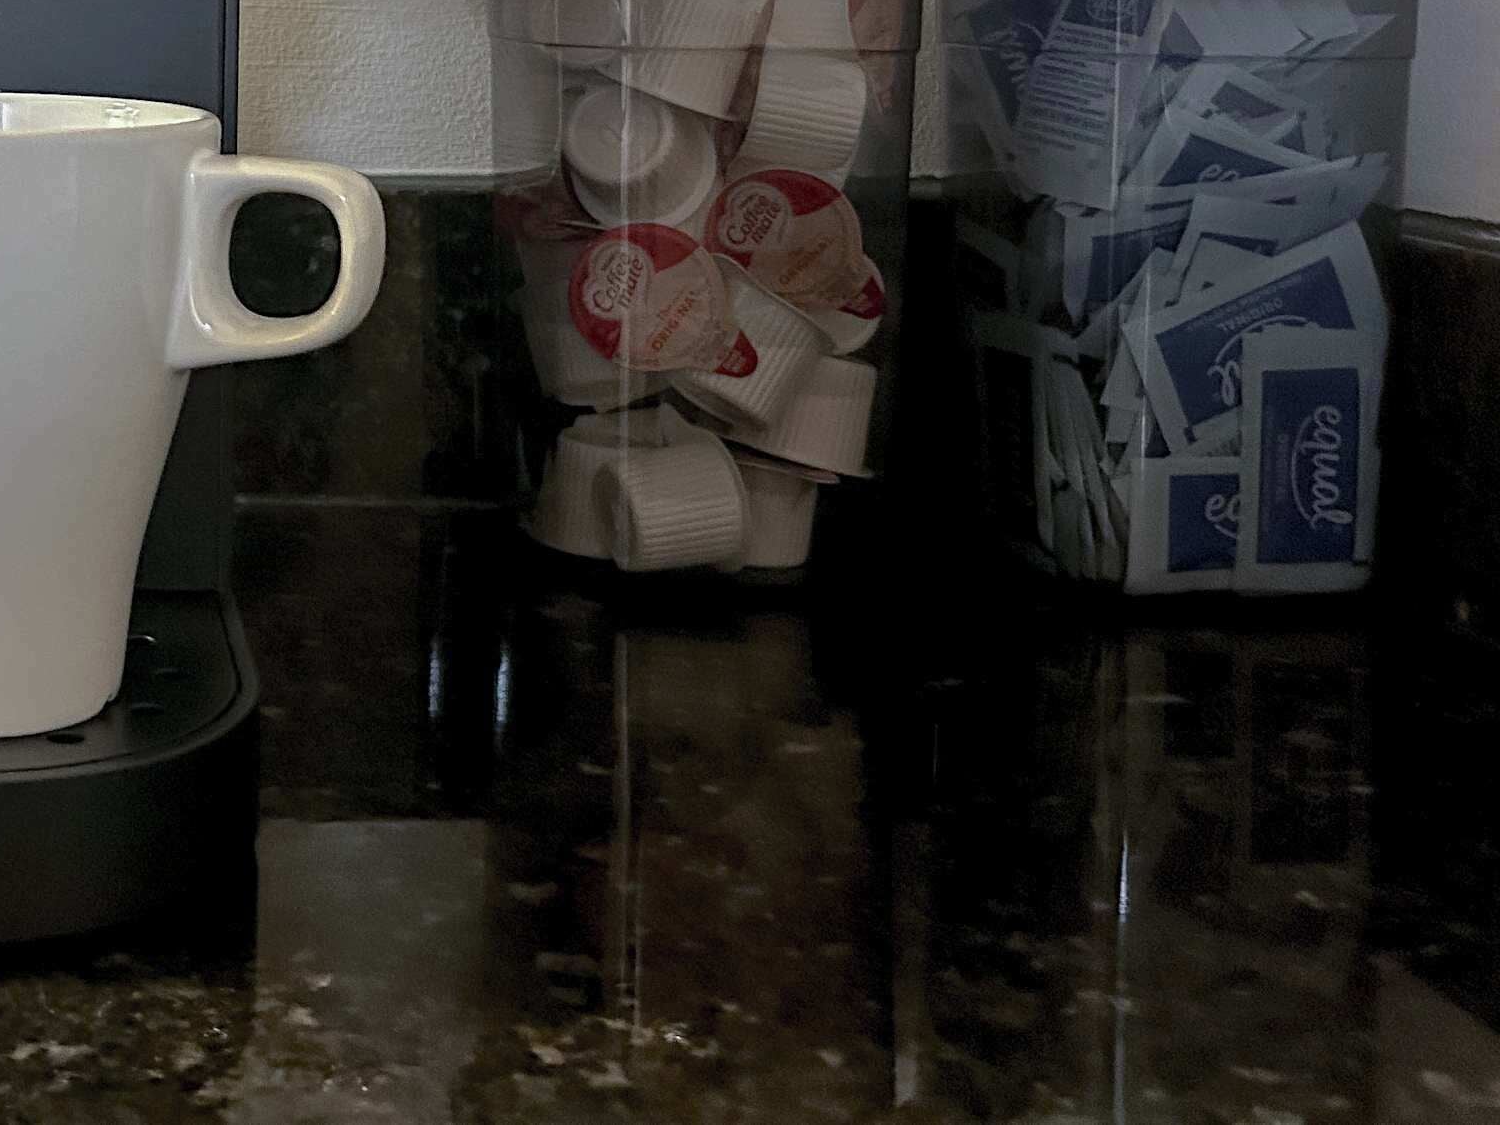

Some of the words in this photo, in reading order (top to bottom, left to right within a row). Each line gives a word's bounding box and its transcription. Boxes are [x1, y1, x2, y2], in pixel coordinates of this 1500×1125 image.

[727, 193, 768, 246] Coffee
[750, 200, 783, 246] mate
[593, 251, 631, 313] Coffee
[619, 256, 645, 309] mate
[1303, 403, 1354, 530] equal
